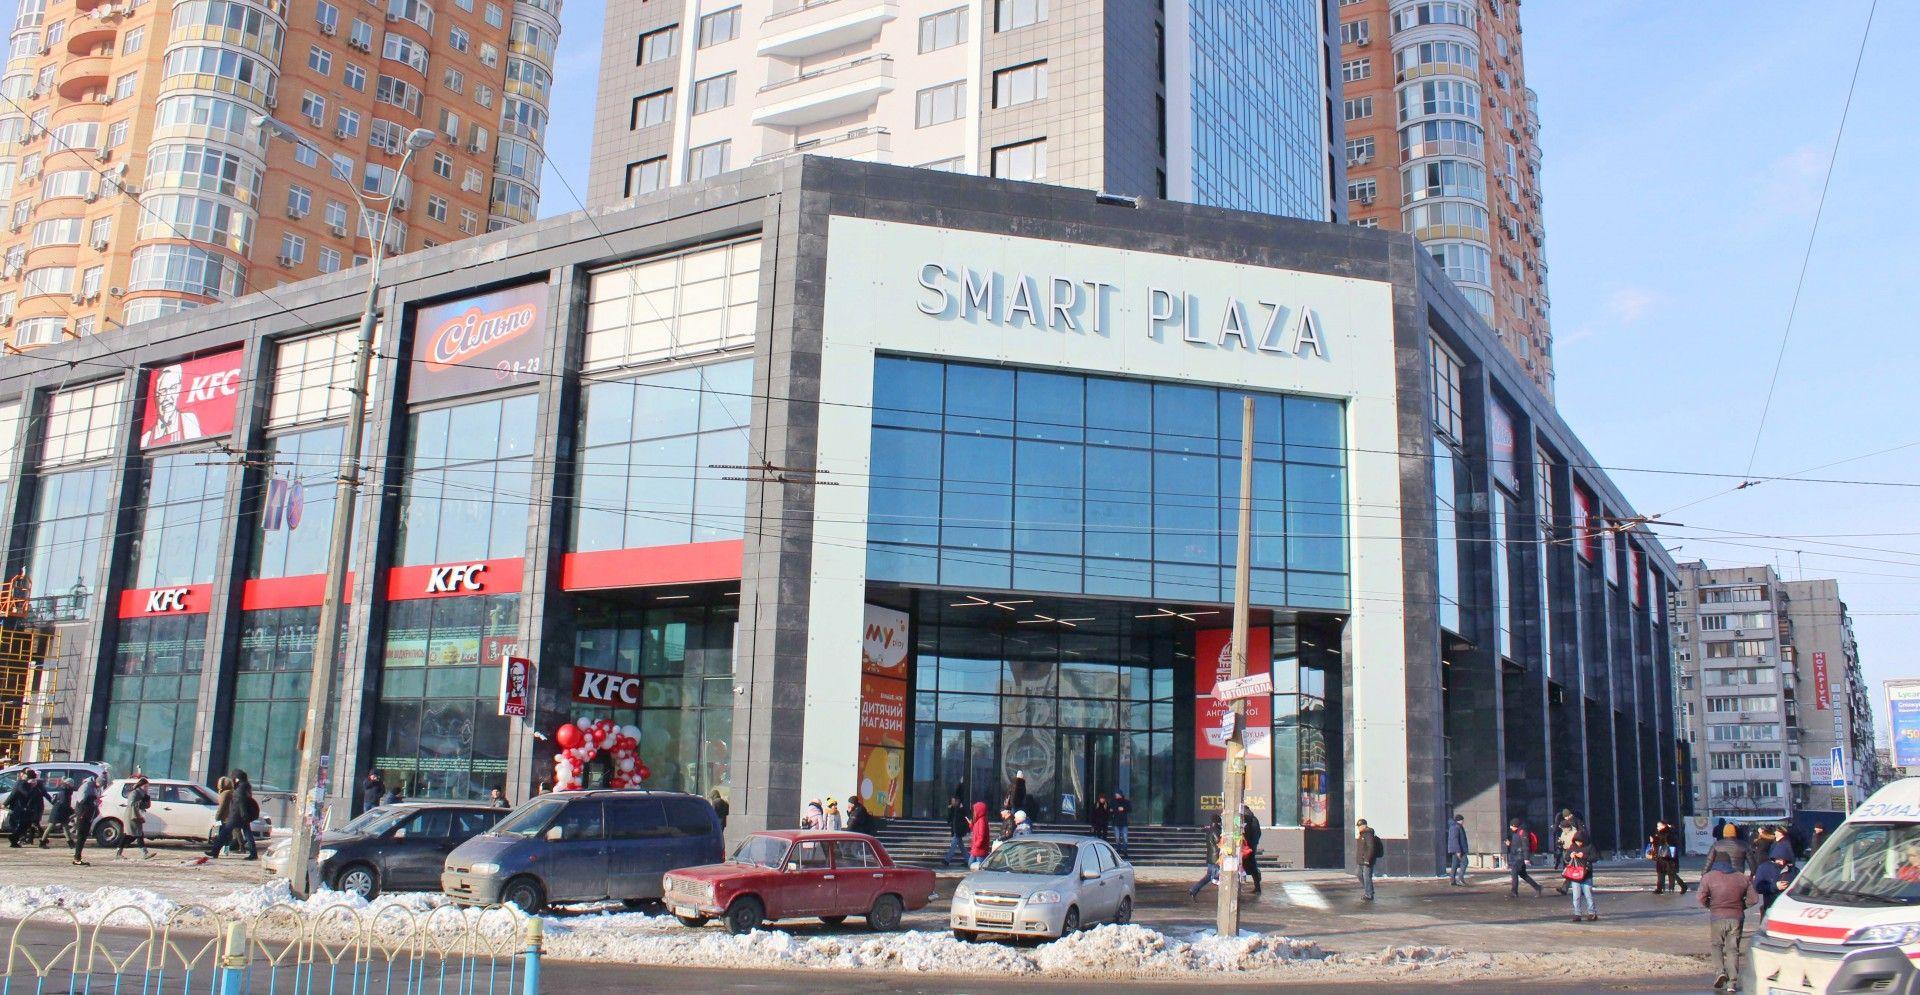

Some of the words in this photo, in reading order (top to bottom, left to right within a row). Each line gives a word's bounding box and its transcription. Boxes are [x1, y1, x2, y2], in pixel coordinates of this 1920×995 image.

[916, 263, 1111, 334] SMART
[1147, 284, 1322, 357] PLAZA
[434, 309, 532, 363] Сільпо
[186, 368, 241, 404] KFC
[425, 563, 485, 593] KFC
[145, 587, 188, 612] KFC
[501, 644, 518, 656] KF
[579, 671, 641, 704] KFC
[1221, 682, 1273, 700] АВТОШКОЛА
[505, 705, 525, 715] KFC
[861, 701, 903, 718] ДИТЯЧИЙ
[861, 716, 903, 732] МАГАЗИН
[1800, 906, 1835, 920] 103
